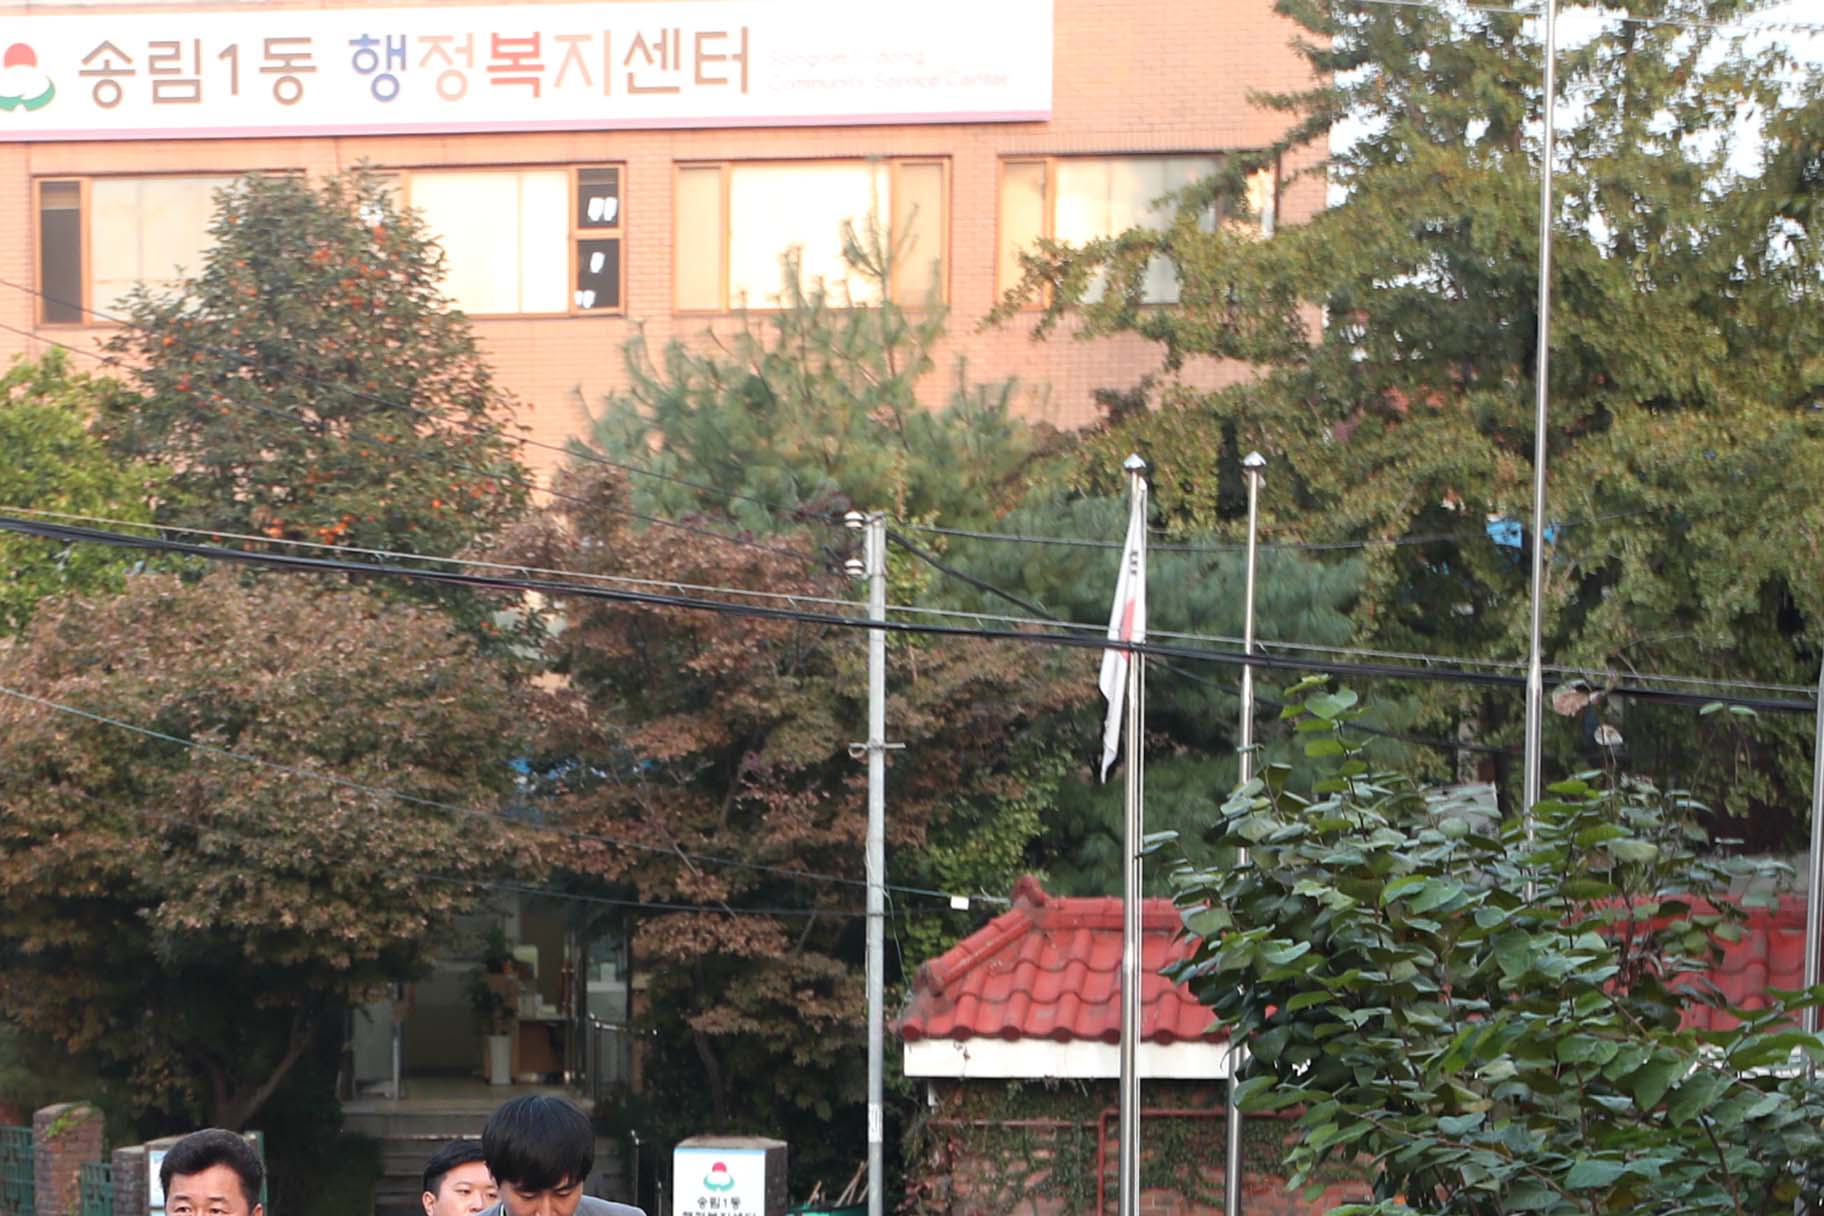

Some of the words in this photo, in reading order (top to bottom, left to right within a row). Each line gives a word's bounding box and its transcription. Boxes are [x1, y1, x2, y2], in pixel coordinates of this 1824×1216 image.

[79, 37, 317, 109] 송림1동
[349, 27, 750, 102] 행정복지센터
[697, 1196, 741, 1209] 송림1동
